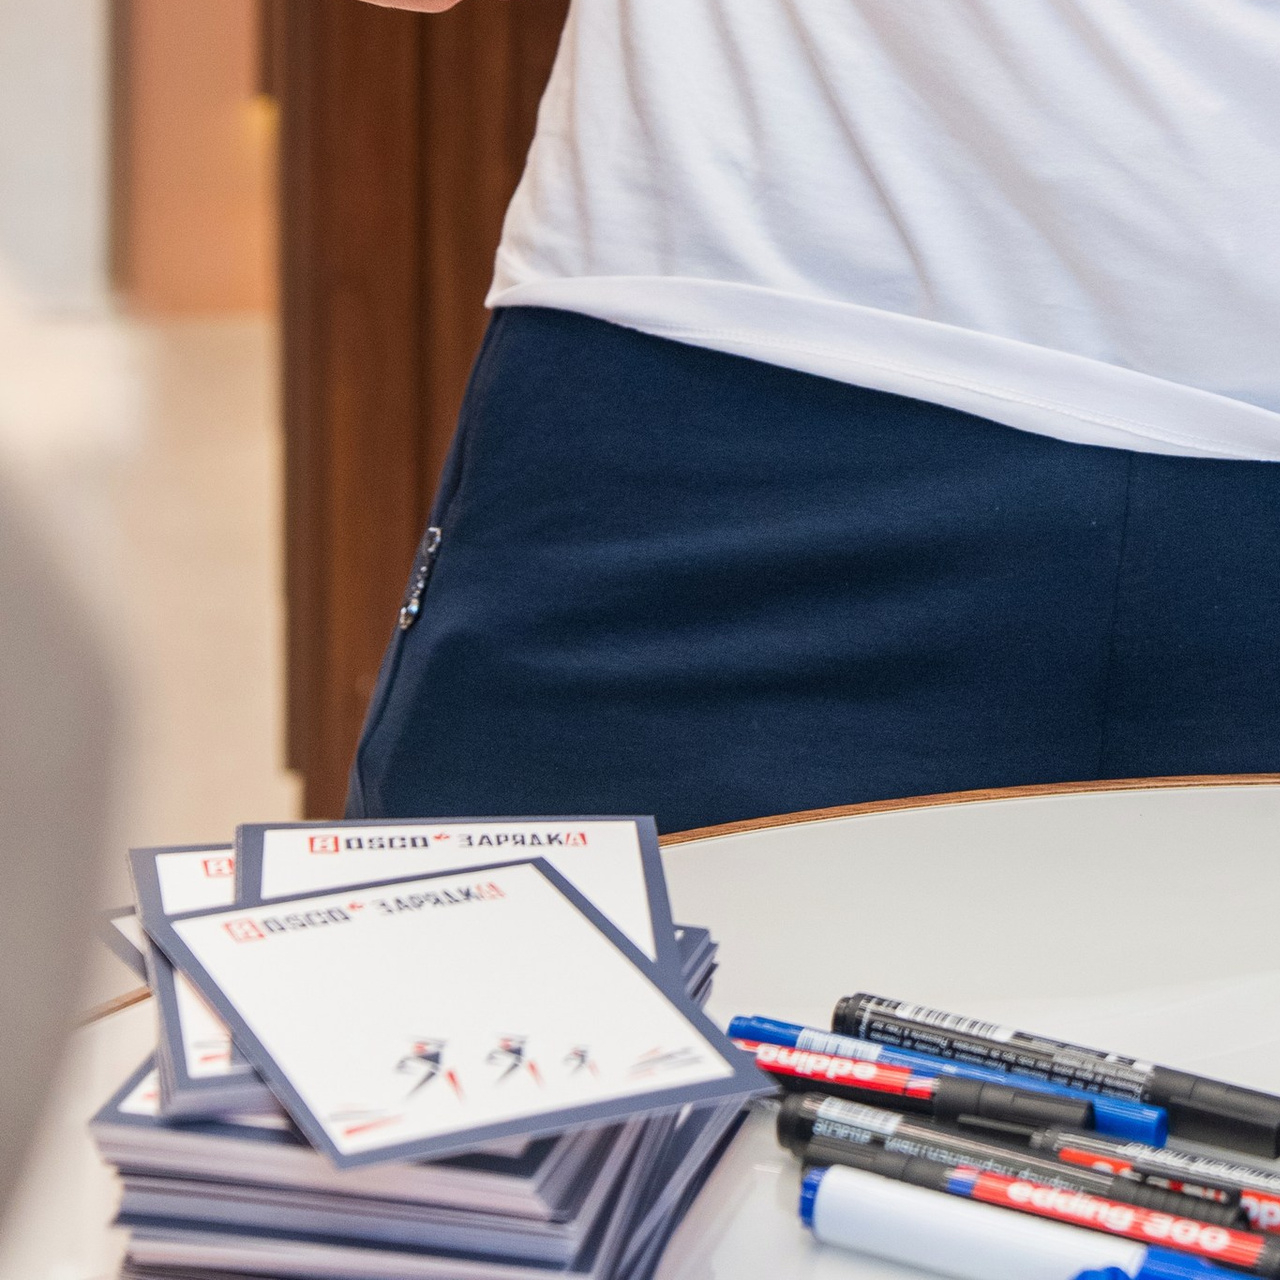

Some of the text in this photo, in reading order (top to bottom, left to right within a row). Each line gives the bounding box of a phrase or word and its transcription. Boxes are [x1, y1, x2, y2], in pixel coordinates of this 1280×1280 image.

[459, 832, 588, 848] ЗАРЯДКА
[1003, 1177, 1232, 1255] edding 300
